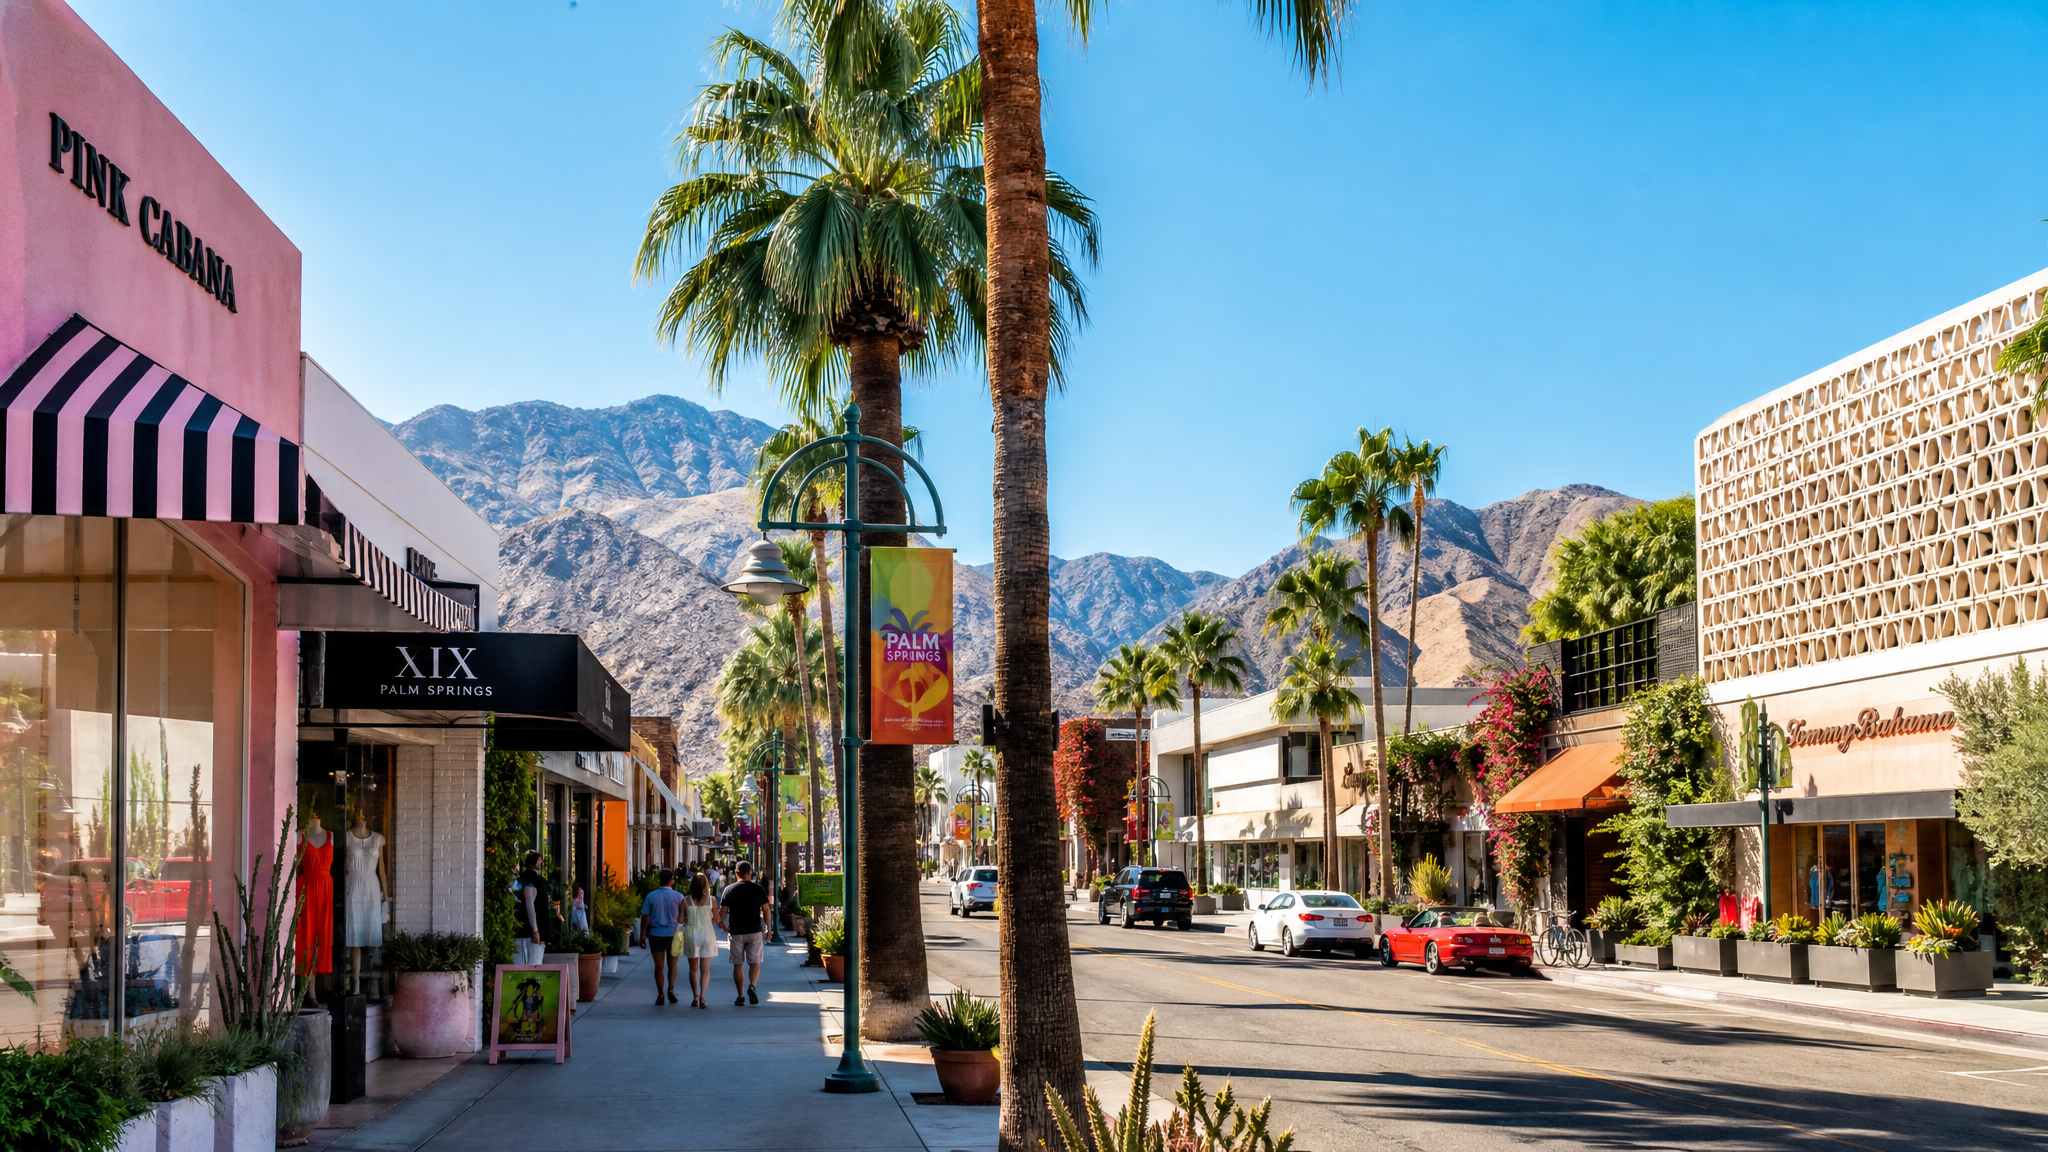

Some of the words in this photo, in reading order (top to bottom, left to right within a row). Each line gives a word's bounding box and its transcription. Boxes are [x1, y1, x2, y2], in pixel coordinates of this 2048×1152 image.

[49, 112, 131, 227] PINK
[139, 195, 238, 314] CABANA
[887, 632, 940, 651] PALM
[394, 645, 479, 680] XIX
[380, 684, 420, 696] PALM
[426, 684, 493, 697] SPRINGS
[1786, 718, 1858, 754] Tommy
[1855, 706, 1957, 741] Bahama
